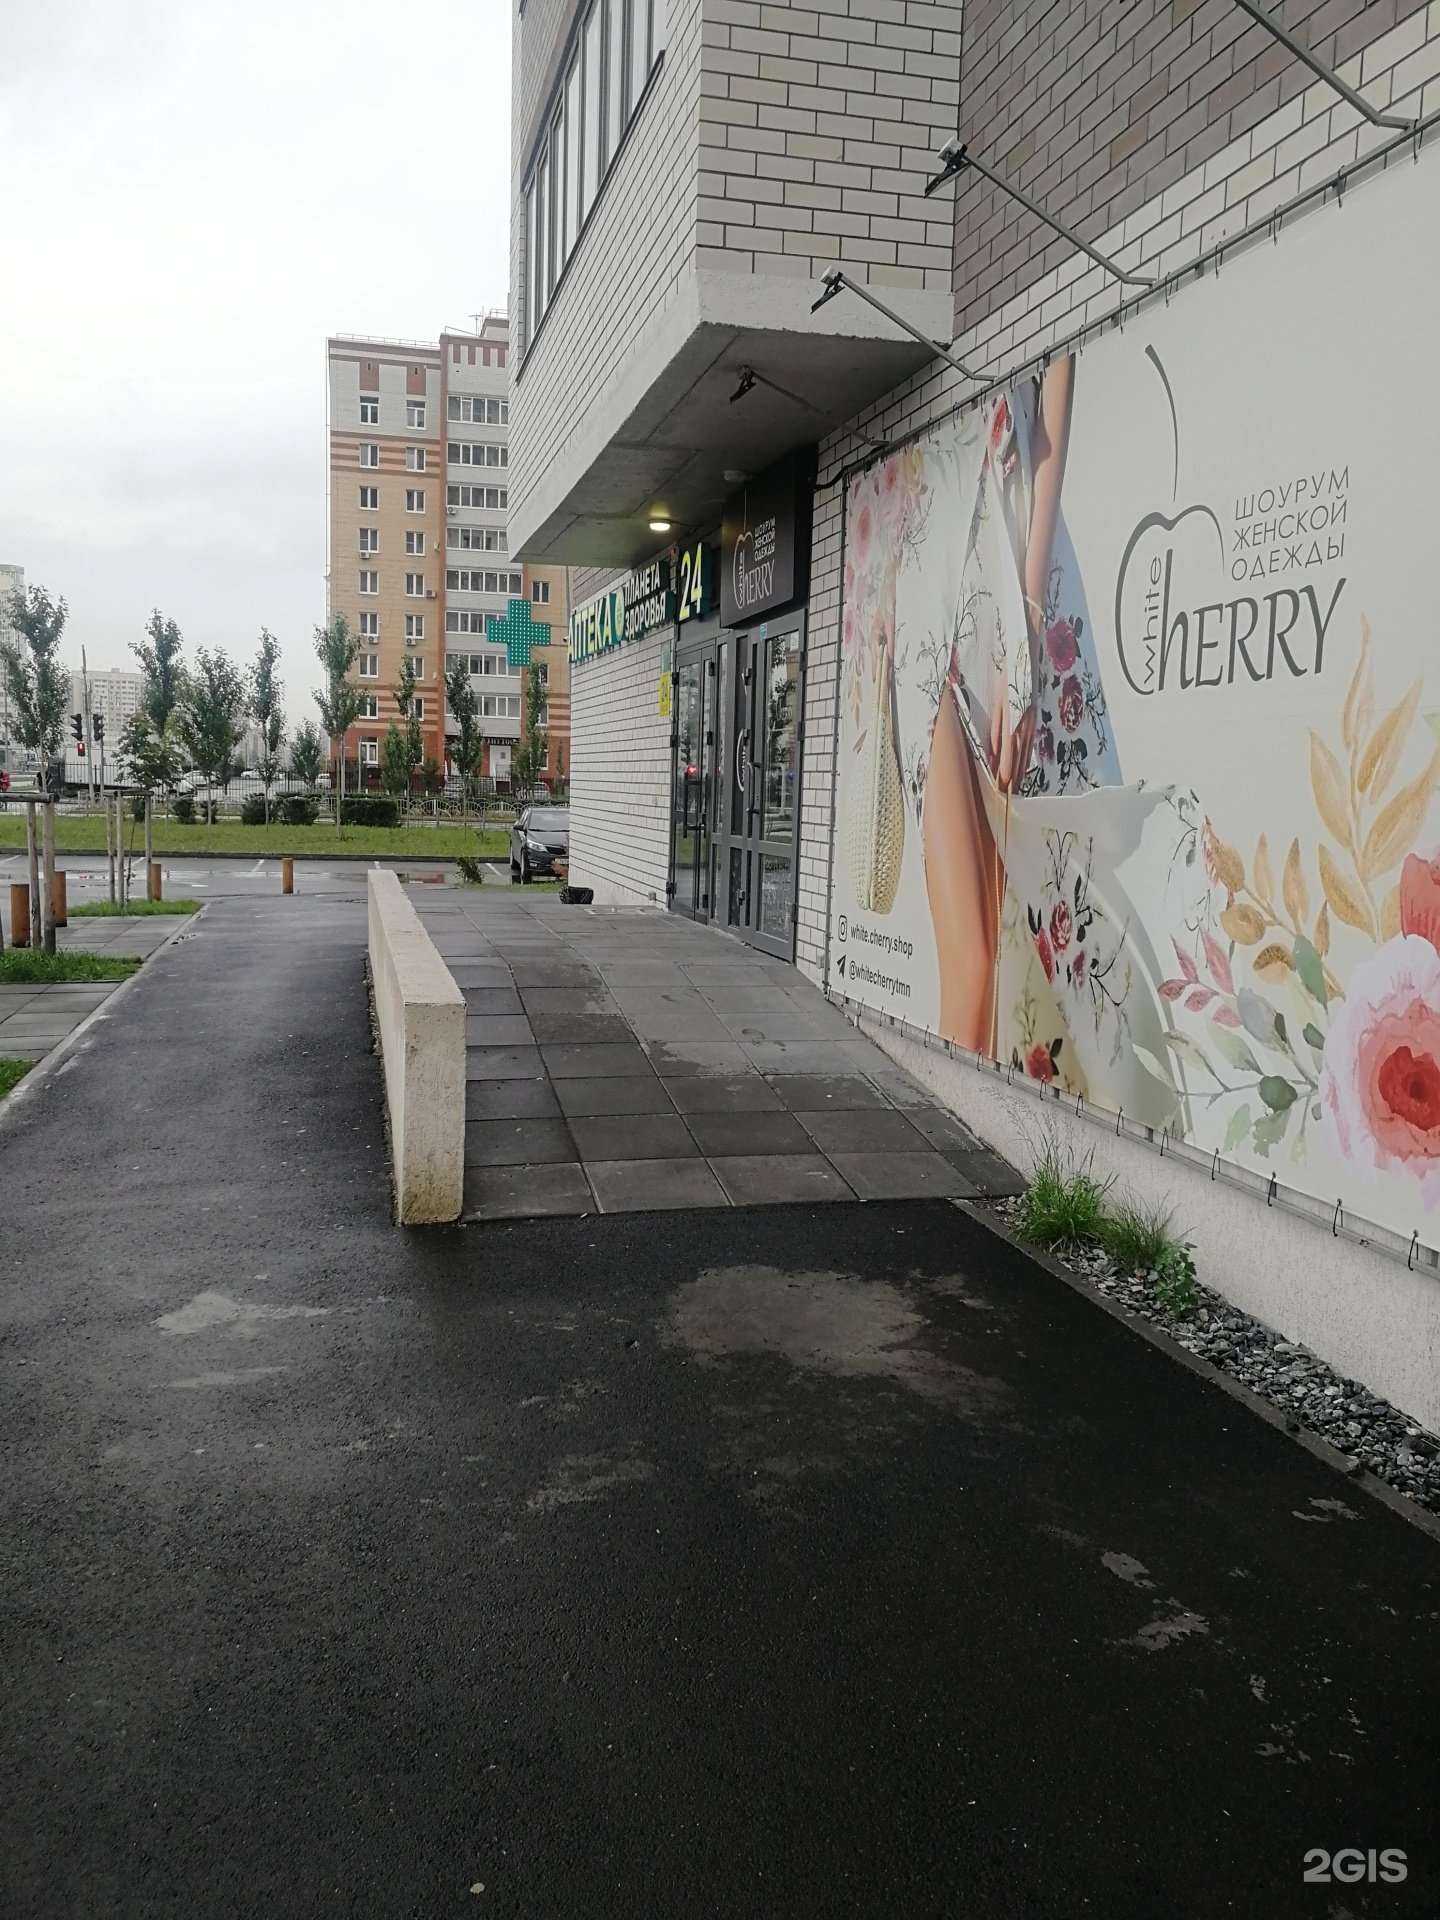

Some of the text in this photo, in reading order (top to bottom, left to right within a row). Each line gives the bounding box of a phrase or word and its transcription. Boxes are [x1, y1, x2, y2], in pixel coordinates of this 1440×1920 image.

[1234, 465, 1350, 521] ШОУРУМ
[1232, 495, 1348, 552] ЖЕНСКОЙ
[679, 542, 703, 620] 24
[1231, 533, 1345, 581] ОДЕЖДЫ
[623, 562, 660, 606] ПЛАНЕТА
[568, 591, 612, 664] АПТЕКА
[625, 591, 666, 640] ЗДОРОВЬЯ
[1142, 555, 1162, 684] white
[850, 924, 913, 960] white.cherry.shop
[849, 961, 911, 998] @whitecherrytmn
